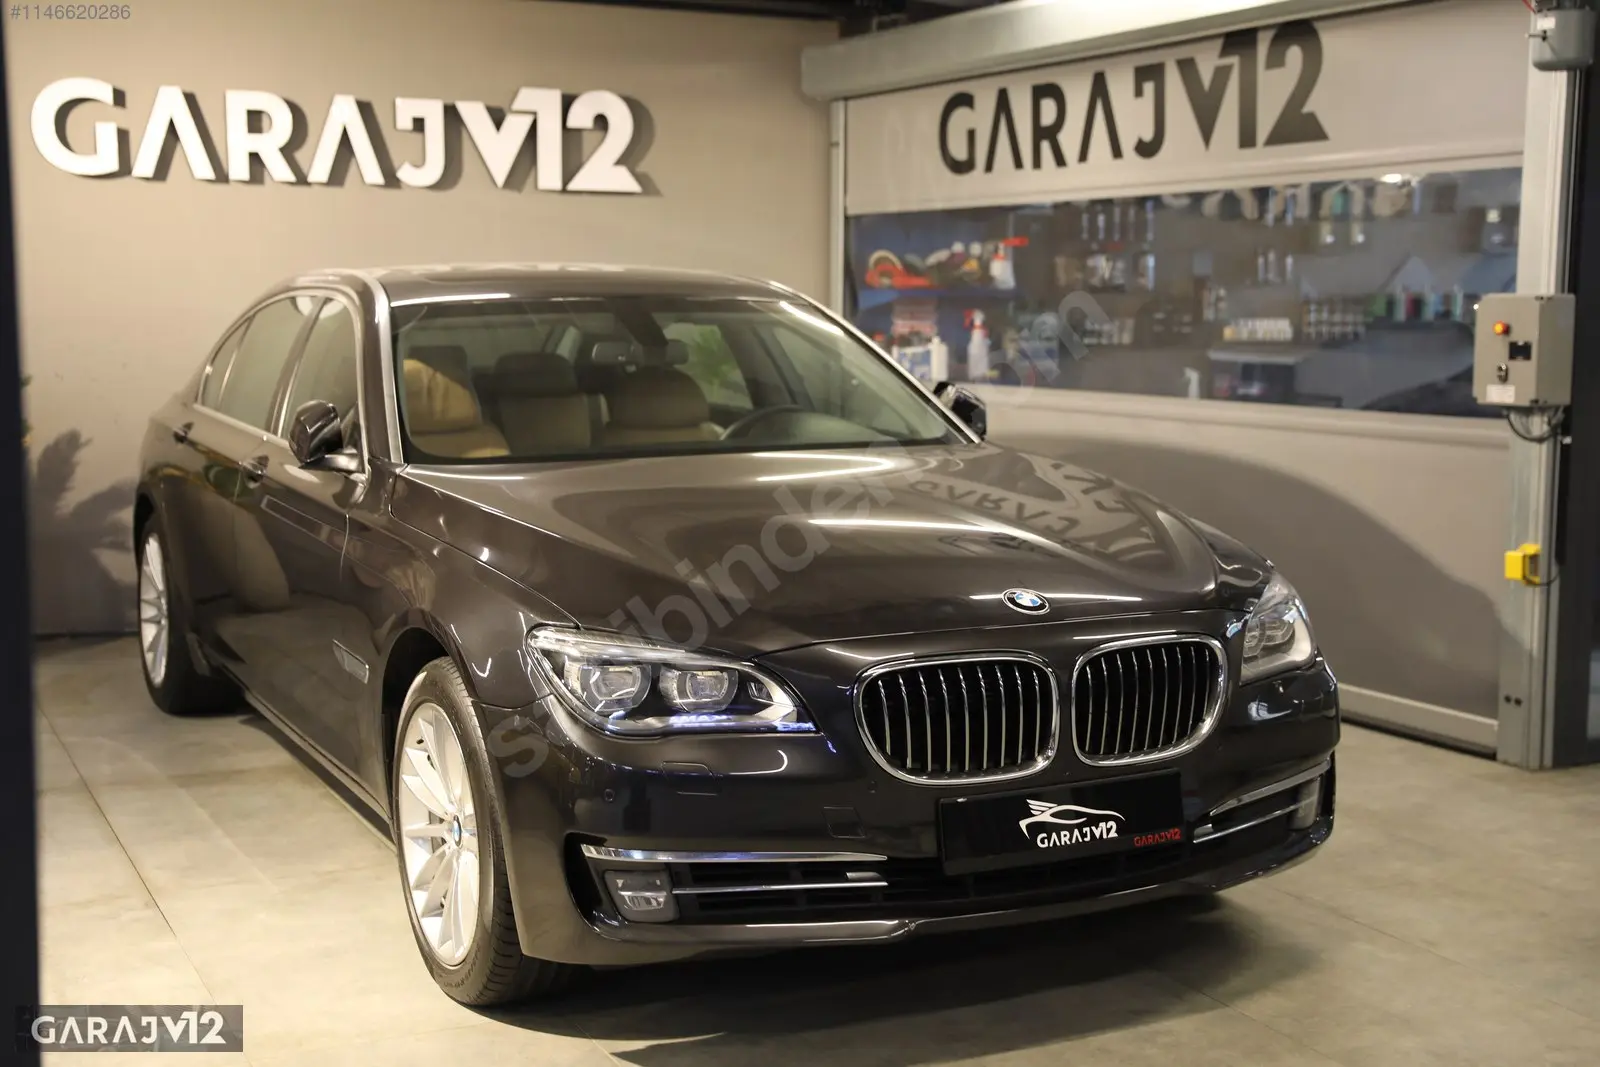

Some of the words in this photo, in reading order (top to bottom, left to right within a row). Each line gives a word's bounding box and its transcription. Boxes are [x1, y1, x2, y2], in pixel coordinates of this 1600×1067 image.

[30, 77, 643, 193] GARAJV12
[938, 20, 1330, 175] GARAJV12
[1036, 821, 1118, 848] GARAJV12
